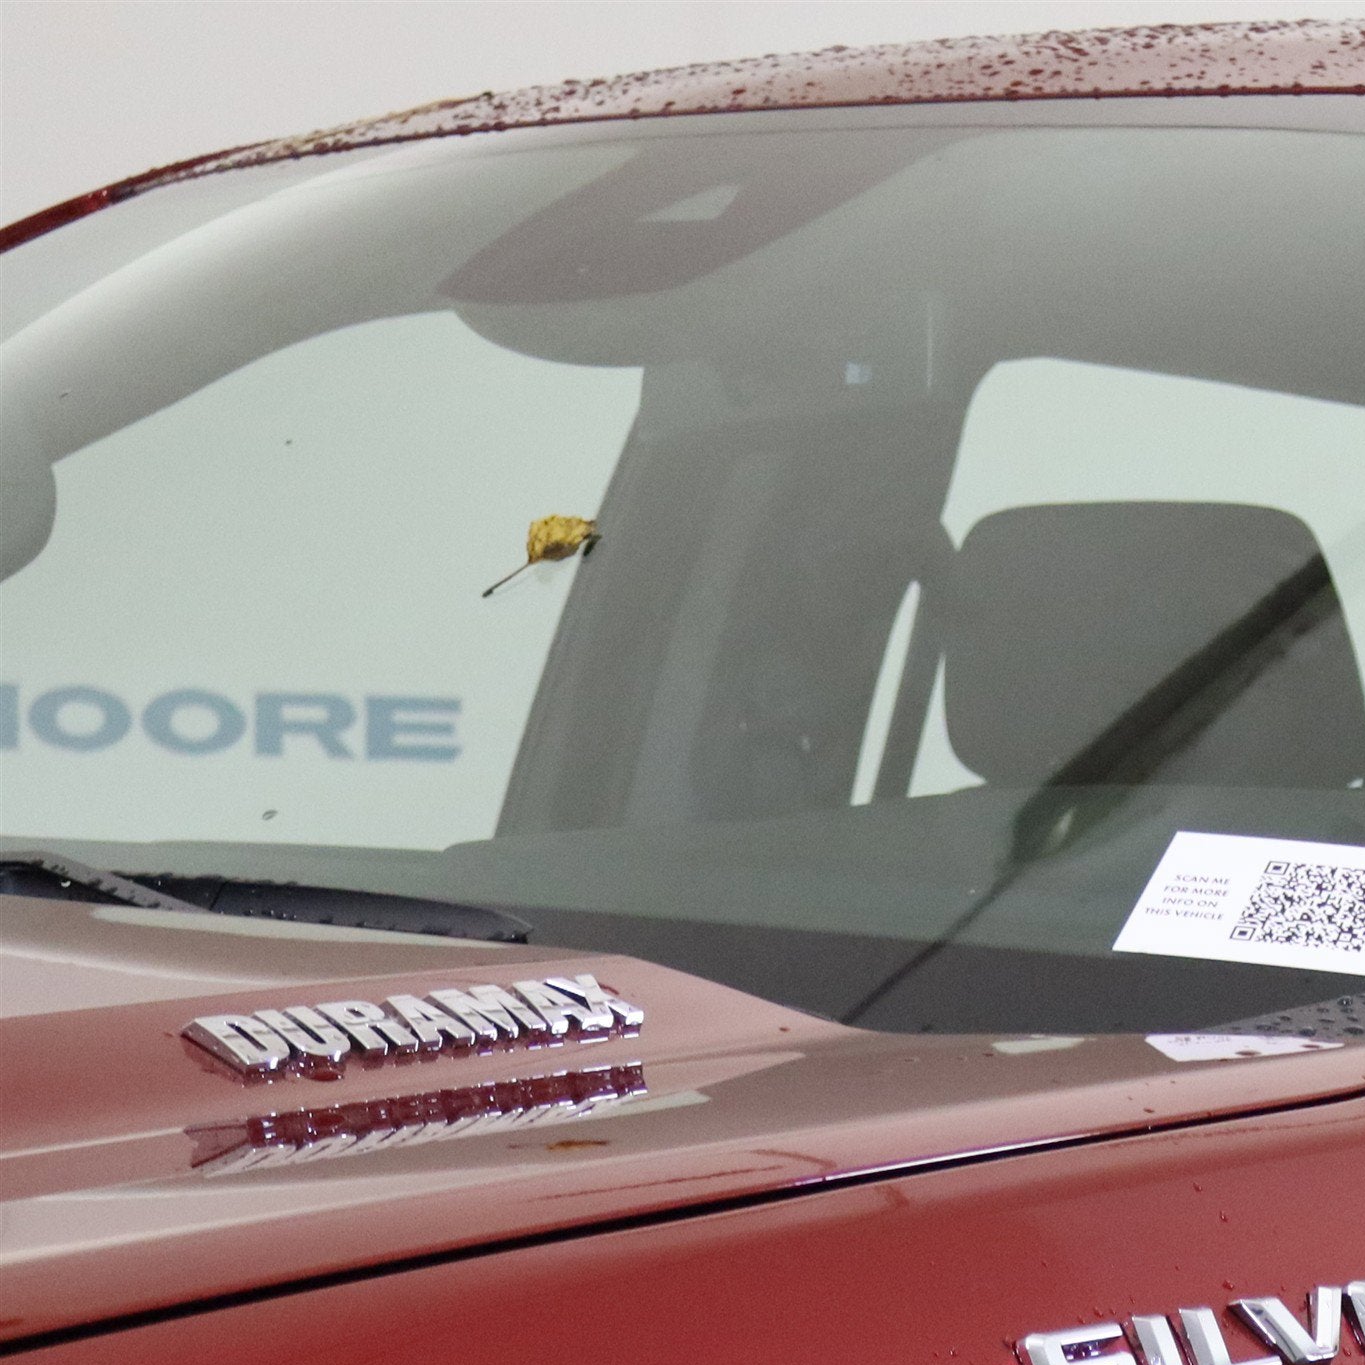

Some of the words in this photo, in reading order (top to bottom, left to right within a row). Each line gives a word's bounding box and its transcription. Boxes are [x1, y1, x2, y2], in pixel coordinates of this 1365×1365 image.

[1176, 875, 1209, 883] SCAN
[1192, 888, 1228, 896] MORE
[1175, 911, 1224, 920] VEHICLE
[180, 973, 645, 1078] DURAMAX
